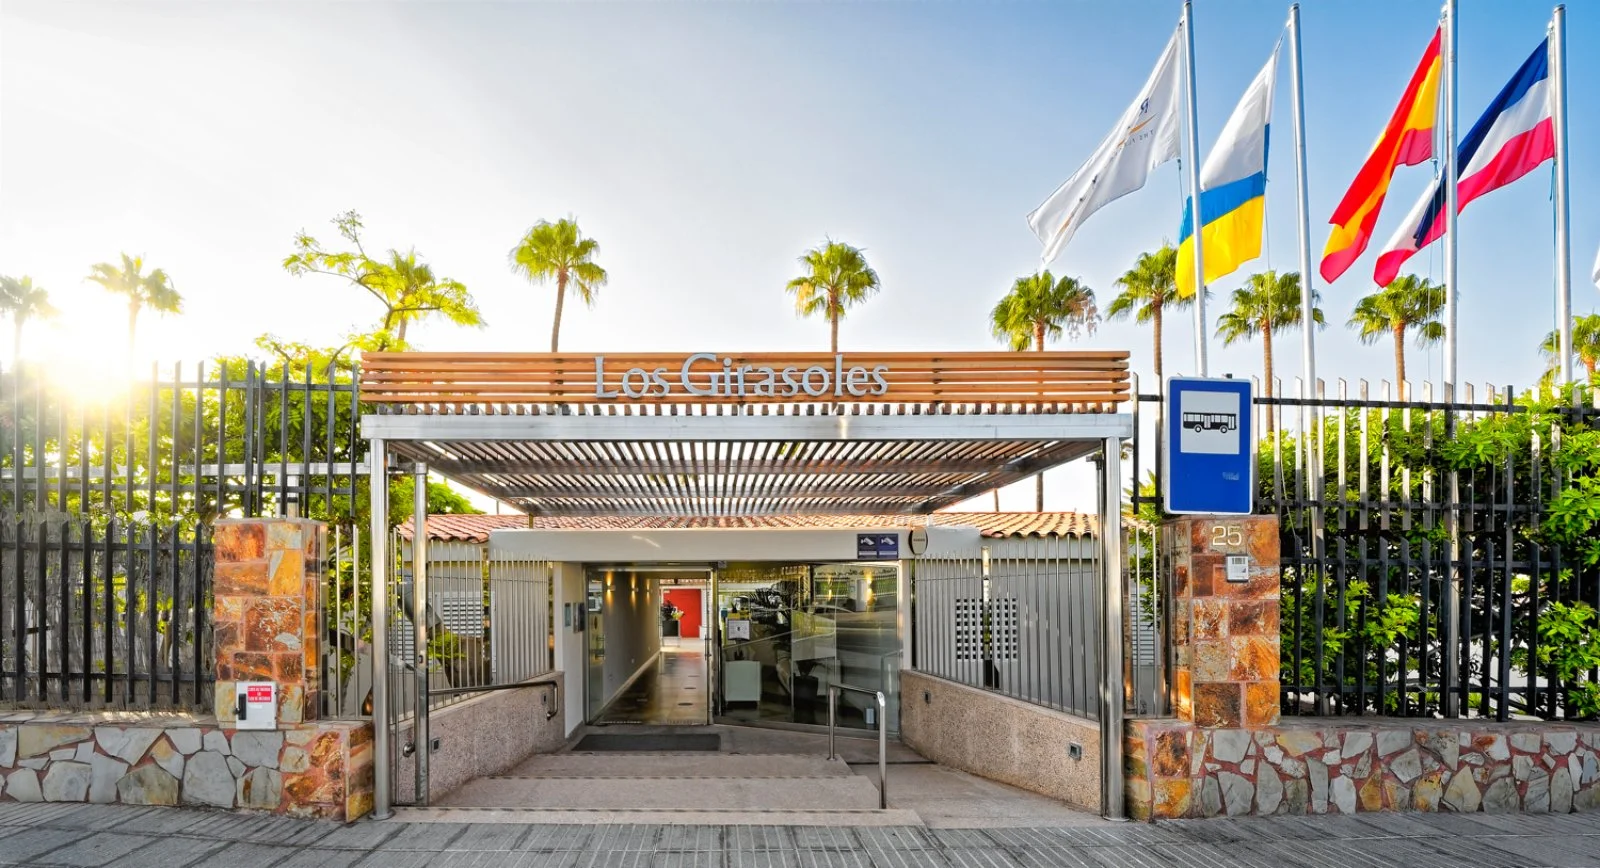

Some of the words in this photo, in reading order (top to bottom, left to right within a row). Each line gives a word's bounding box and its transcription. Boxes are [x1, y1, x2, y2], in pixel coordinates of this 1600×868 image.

[595, 356, 671, 398] Los
[680, 353, 889, 397] Girasoles
[1212, 525, 1242, 546] 25
